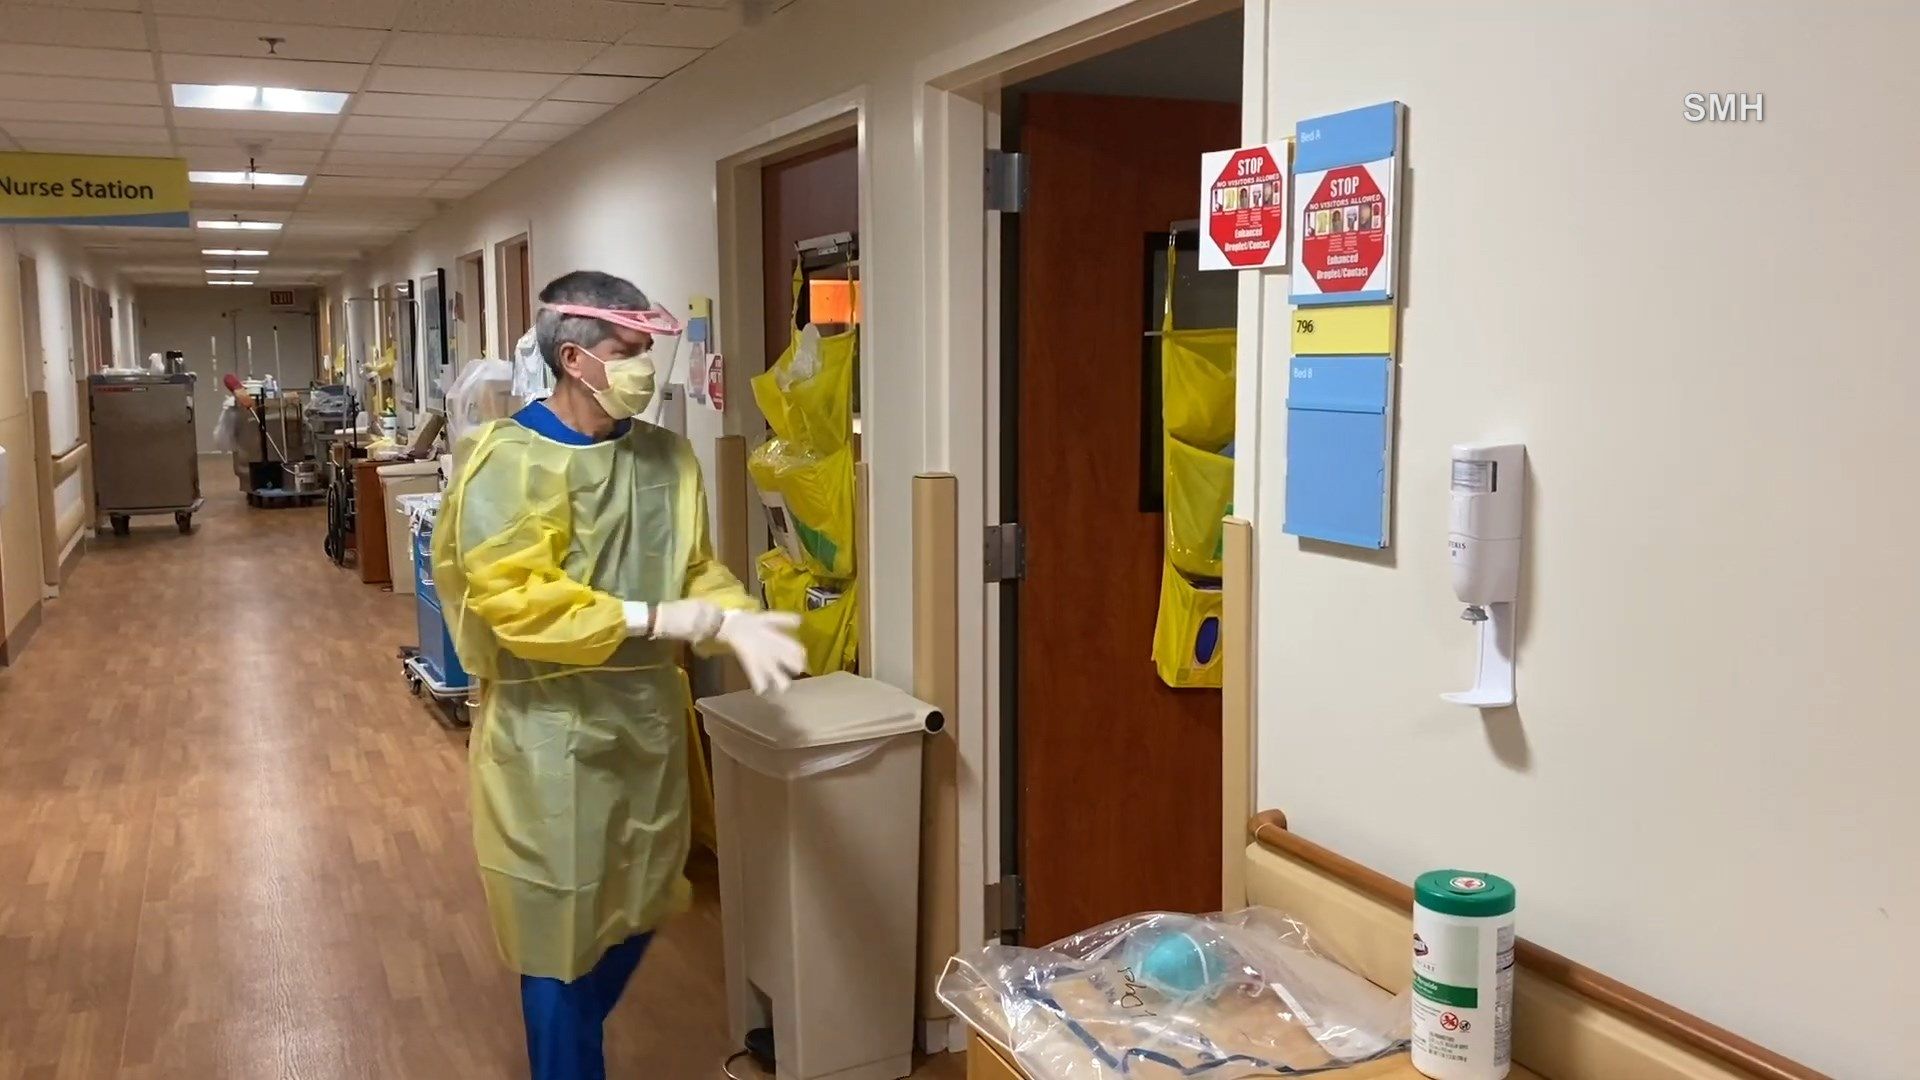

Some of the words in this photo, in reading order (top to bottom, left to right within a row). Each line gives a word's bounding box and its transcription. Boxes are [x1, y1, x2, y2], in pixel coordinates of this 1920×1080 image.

[1301, 129, 1314, 143] Bed
[1237, 156, 1264, 176] STOP
[1228, 177, 1255, 187] VISITORS
[1256, 173, 1280, 183] ALLOWED
[1330, 176, 1360, 198] STOP
[0, 176, 64, 197] Nurse
[71, 178, 154, 200] Station
[1320, 199, 1350, 209] VISITORS
[1351, 194, 1381, 205] ALLOWED
[1234, 228, 1263, 239] Enhanced
[1224, 240, 1271, 252] Droplet/Contact
[1327, 253, 1359, 265] Enhanced
[1316, 267, 1369, 280] Droplet/Contact
[1296, 319, 1314, 333] 796
[1294, 367, 1306, 379] Bed
